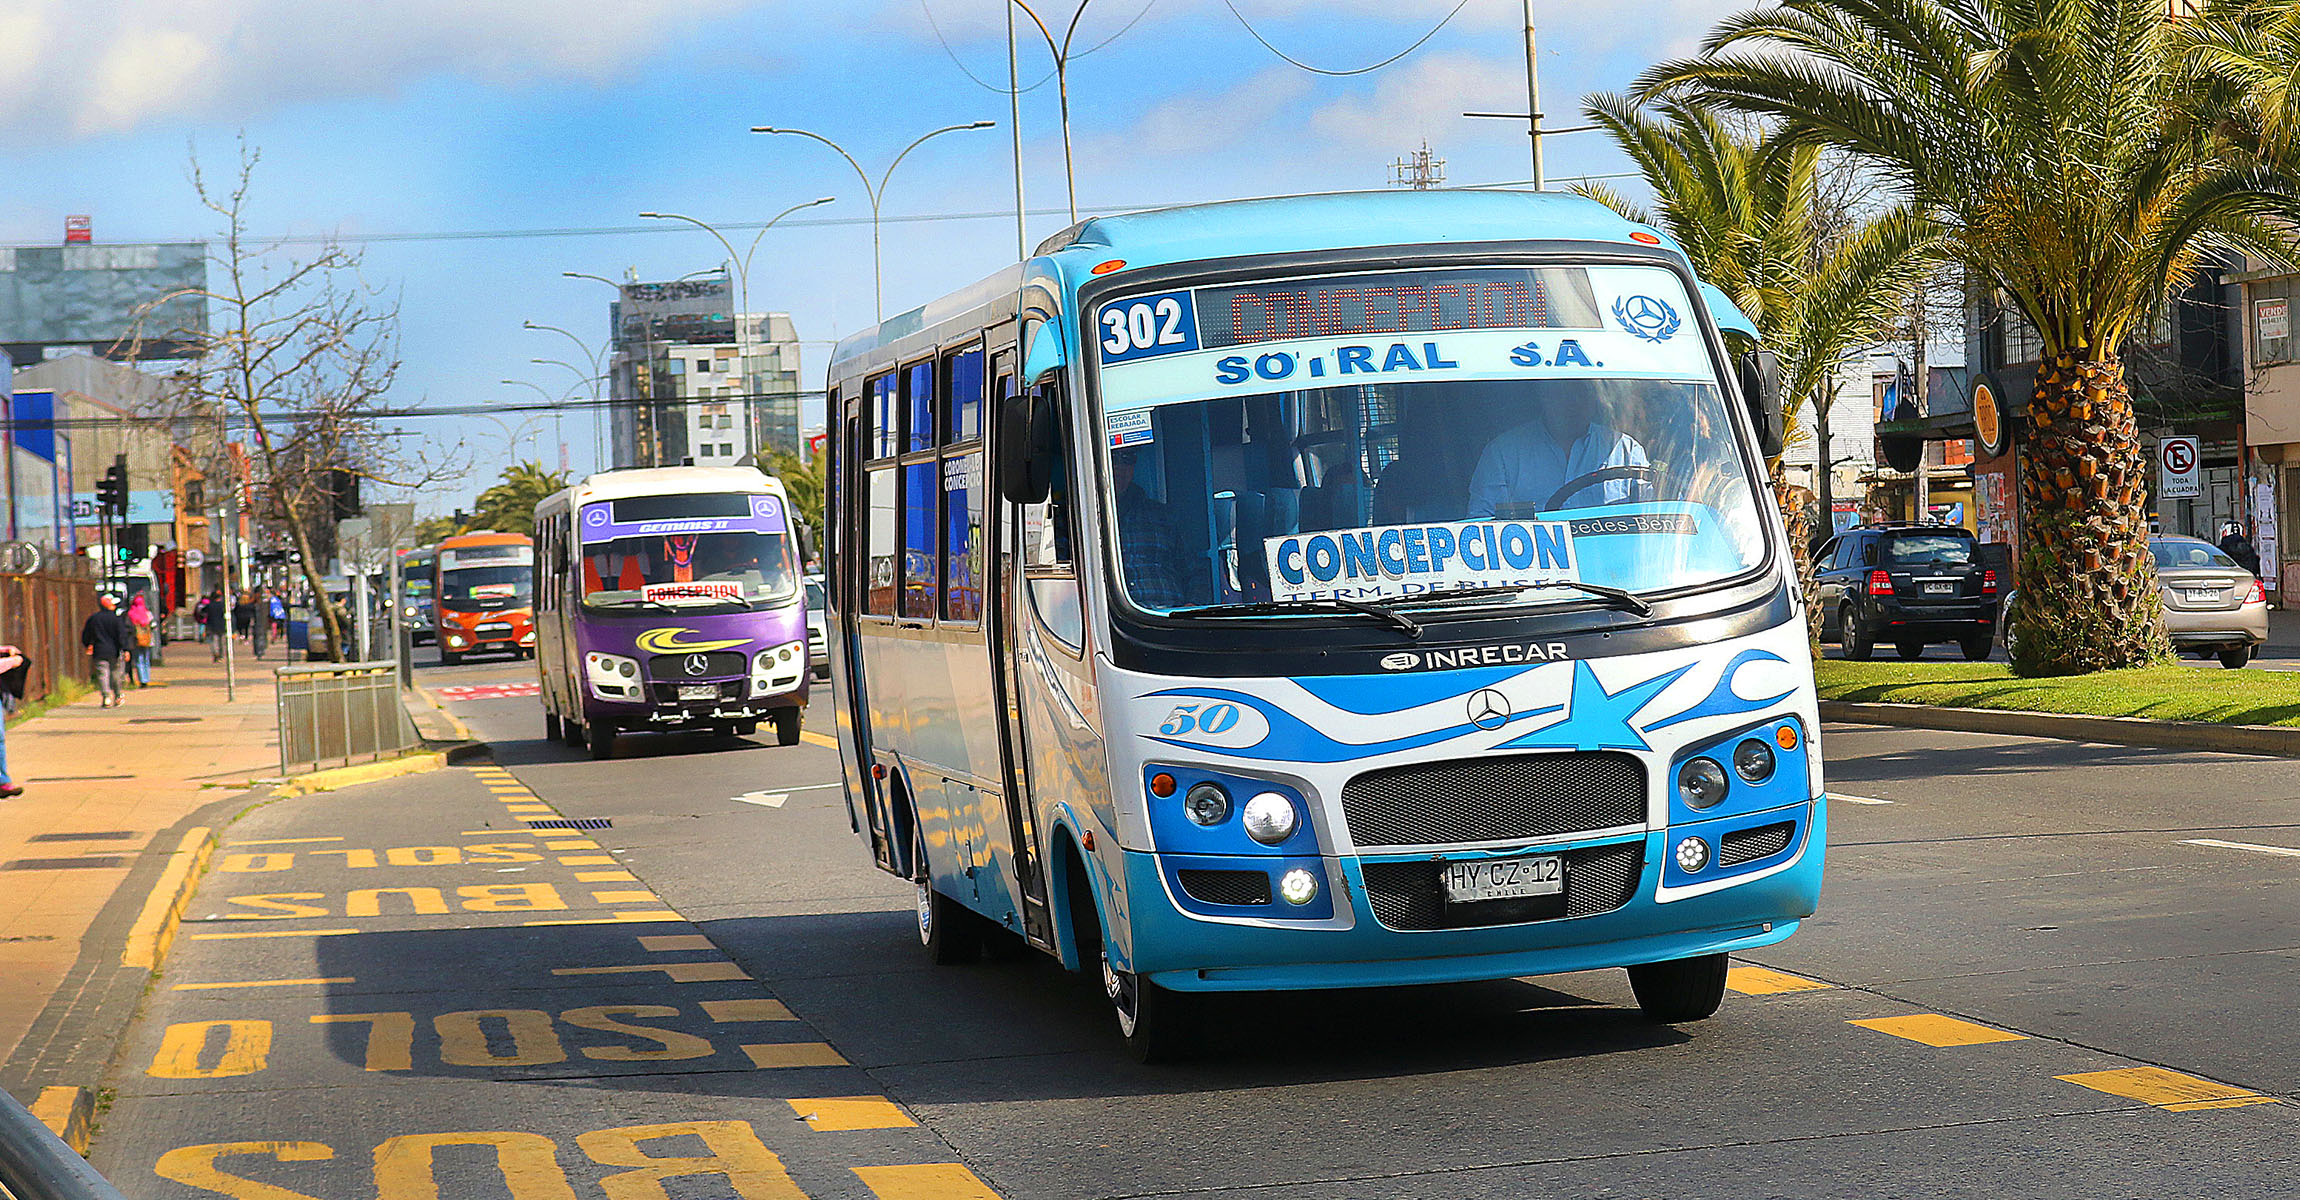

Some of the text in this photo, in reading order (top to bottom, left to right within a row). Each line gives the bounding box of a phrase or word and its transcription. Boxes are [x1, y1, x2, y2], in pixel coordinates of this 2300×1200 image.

[1100, 298, 1185, 354] 302
[1231, 280, 1548, 343] CONCEPCION
[1509, 339, 1604, 368] S.A.
[1110, 414, 1141, 424] ESCOLAR
[1111, 419, 1146, 429] REBAJADA
[639, 520, 729, 533] GEMINIS II
[1277, 523, 1571, 585] CONCEPCION
[647, 584, 738, 602] CONCEPCION
[1425, 642, 1569, 670] INRECAR
[1159, 702, 1241, 737] 50
[218, 842, 546, 873] SOLO
[226, 883, 568, 920] BUS
[1487, 888, 1527, 897] CHILE
[145, 1004, 718, 1079] SOLO
